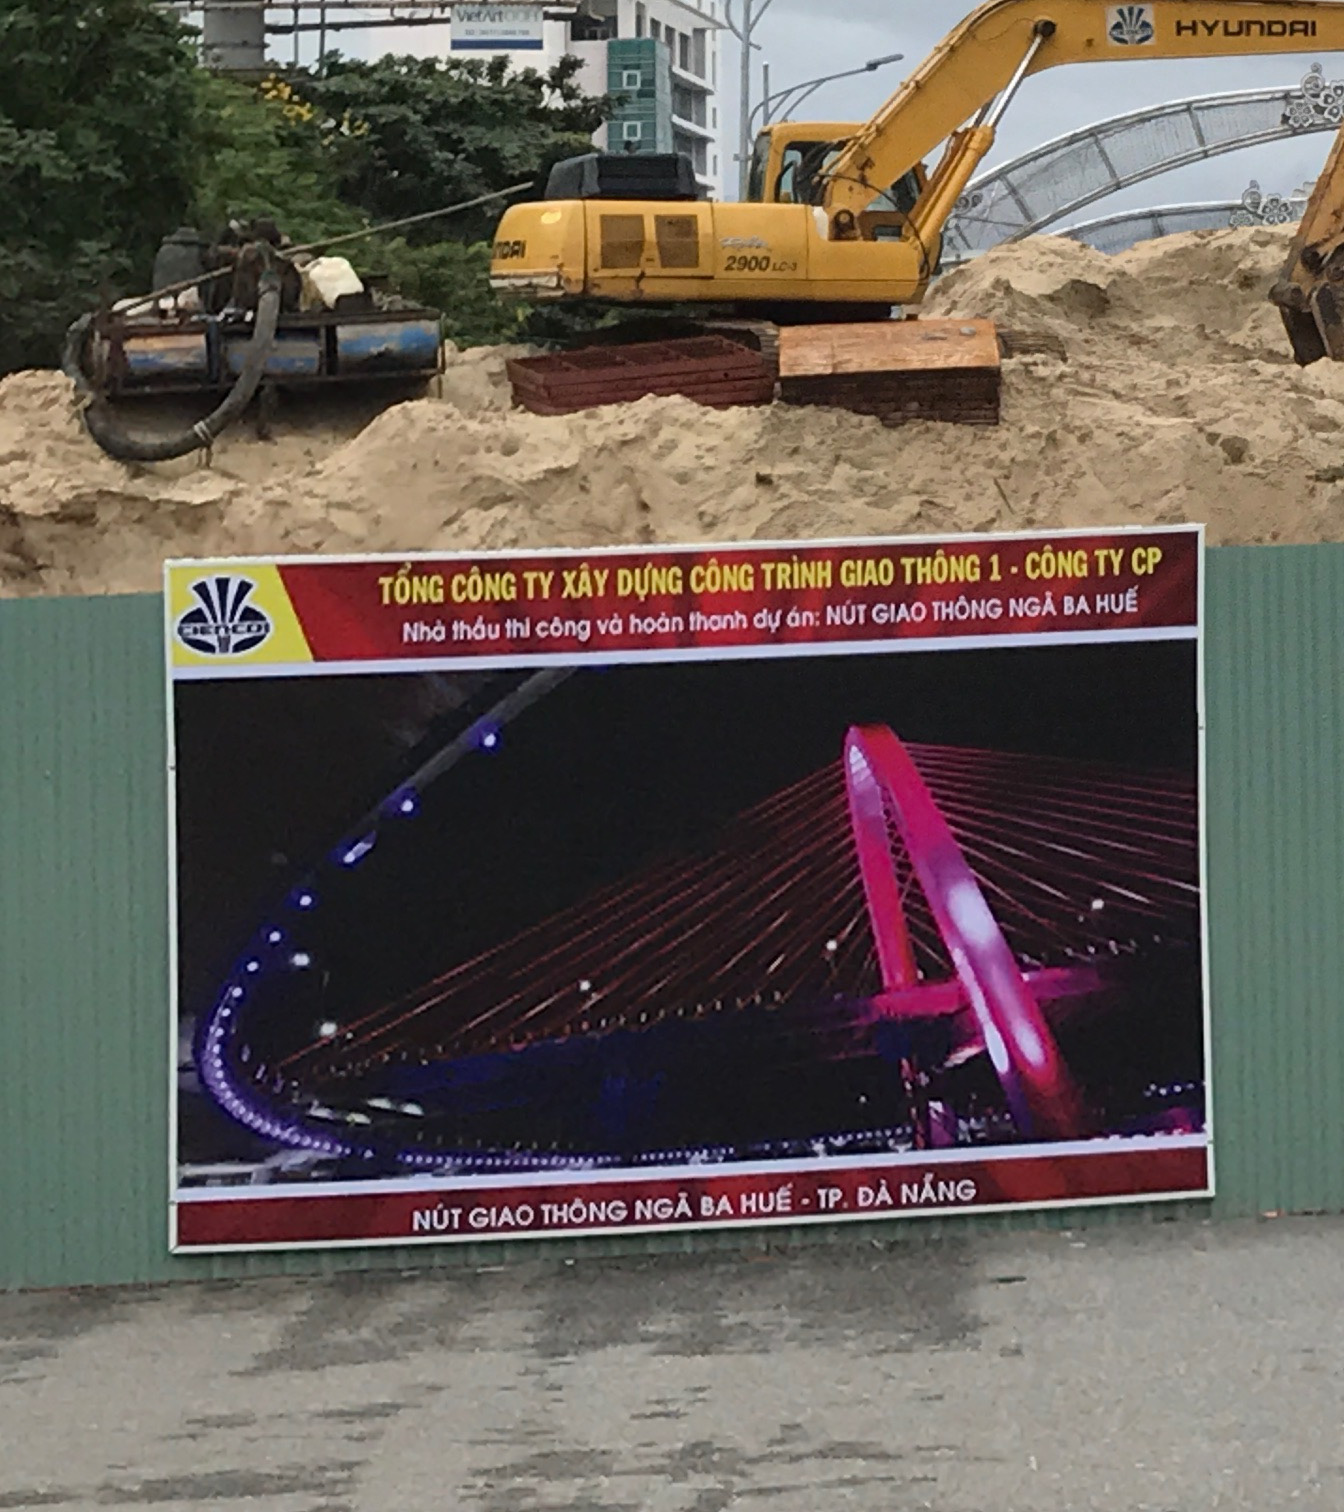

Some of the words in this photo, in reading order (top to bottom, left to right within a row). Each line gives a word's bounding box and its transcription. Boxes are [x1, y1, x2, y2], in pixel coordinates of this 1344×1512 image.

[1175, 19, 1317, 37] HYUNDAI
[724, 255, 770, 272] 2900
[378, 562, 444, 605] TỔNG
[450, 565, 517, 603] CÔNG
[523, 571, 555, 600] TY
[561, 562, 609, 599] XÂY
[616, 563, 683, 602] DỰNG
[689, 557, 754, 594] CÔNG
[760, 555, 832, 591] TRÌNH
[840, 558, 894, 588] GIAO
[900, 548, 981, 585] THÔNG
[989, 553, 1002, 582] 1
[1025, 544, 1088, 580] CÔNG
[1093, 548, 1124, 577] TY
[1131, 546, 1163, 576] CP
[504, 617, 531, 639] thi
[534, 616, 591, 639] công
[596, 612, 623, 635] và
[785, 605, 820, 628] án:
[826, 599, 867, 626] NÚT
[871, 601, 927, 625] GIAO
[931, 595, 1003, 622] THÔNG
[1063, 594, 1091, 616] BA
[412, 1203, 463, 1231] NÚT
[468, 1204, 535, 1228] GIAO
[540, 1197, 628, 1224] THÔNG
[700, 1194, 734, 1217] BA
[817, 1188, 848, 1209] TP.
[857, 1179, 894, 1207] ĐÀ
